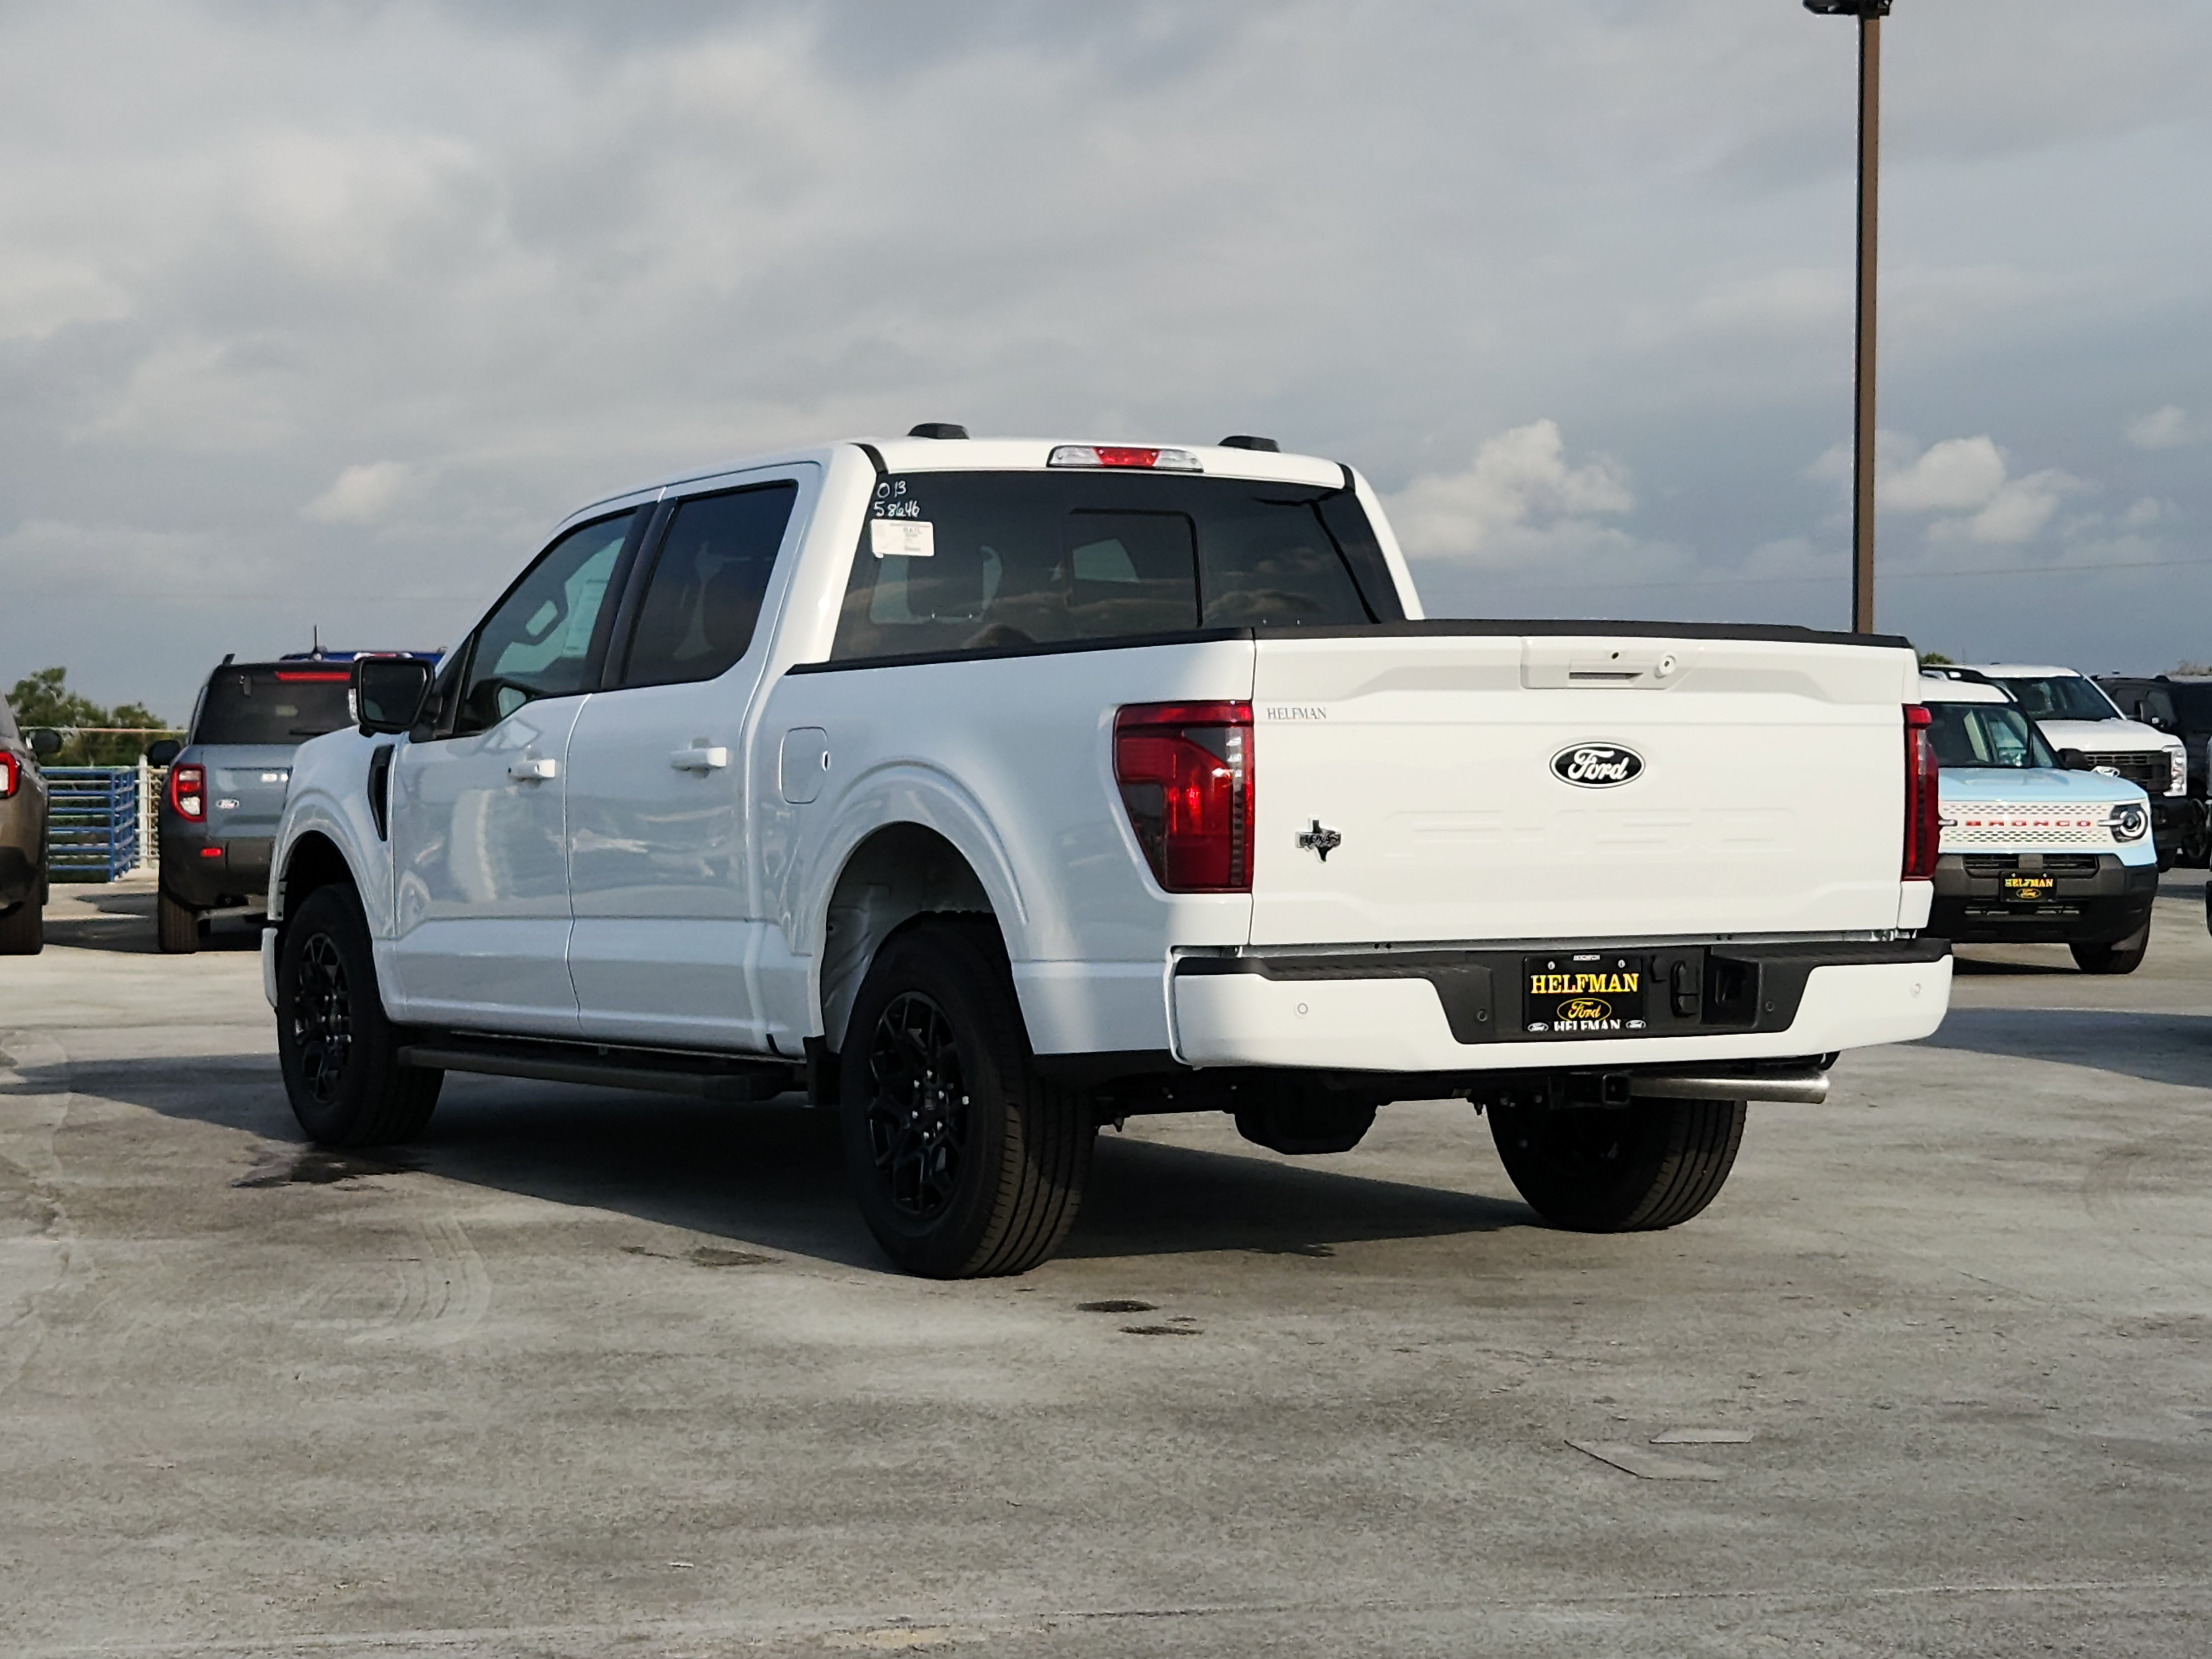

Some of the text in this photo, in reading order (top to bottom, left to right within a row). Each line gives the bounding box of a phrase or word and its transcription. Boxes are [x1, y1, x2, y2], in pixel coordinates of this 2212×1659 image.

[1267, 707, 1326, 720] HELFMAN
[1568, 749, 1629, 780] Ford
[1530, 973, 1640, 994] HELFMAN
[1568, 1001, 1601, 1018] Ford
